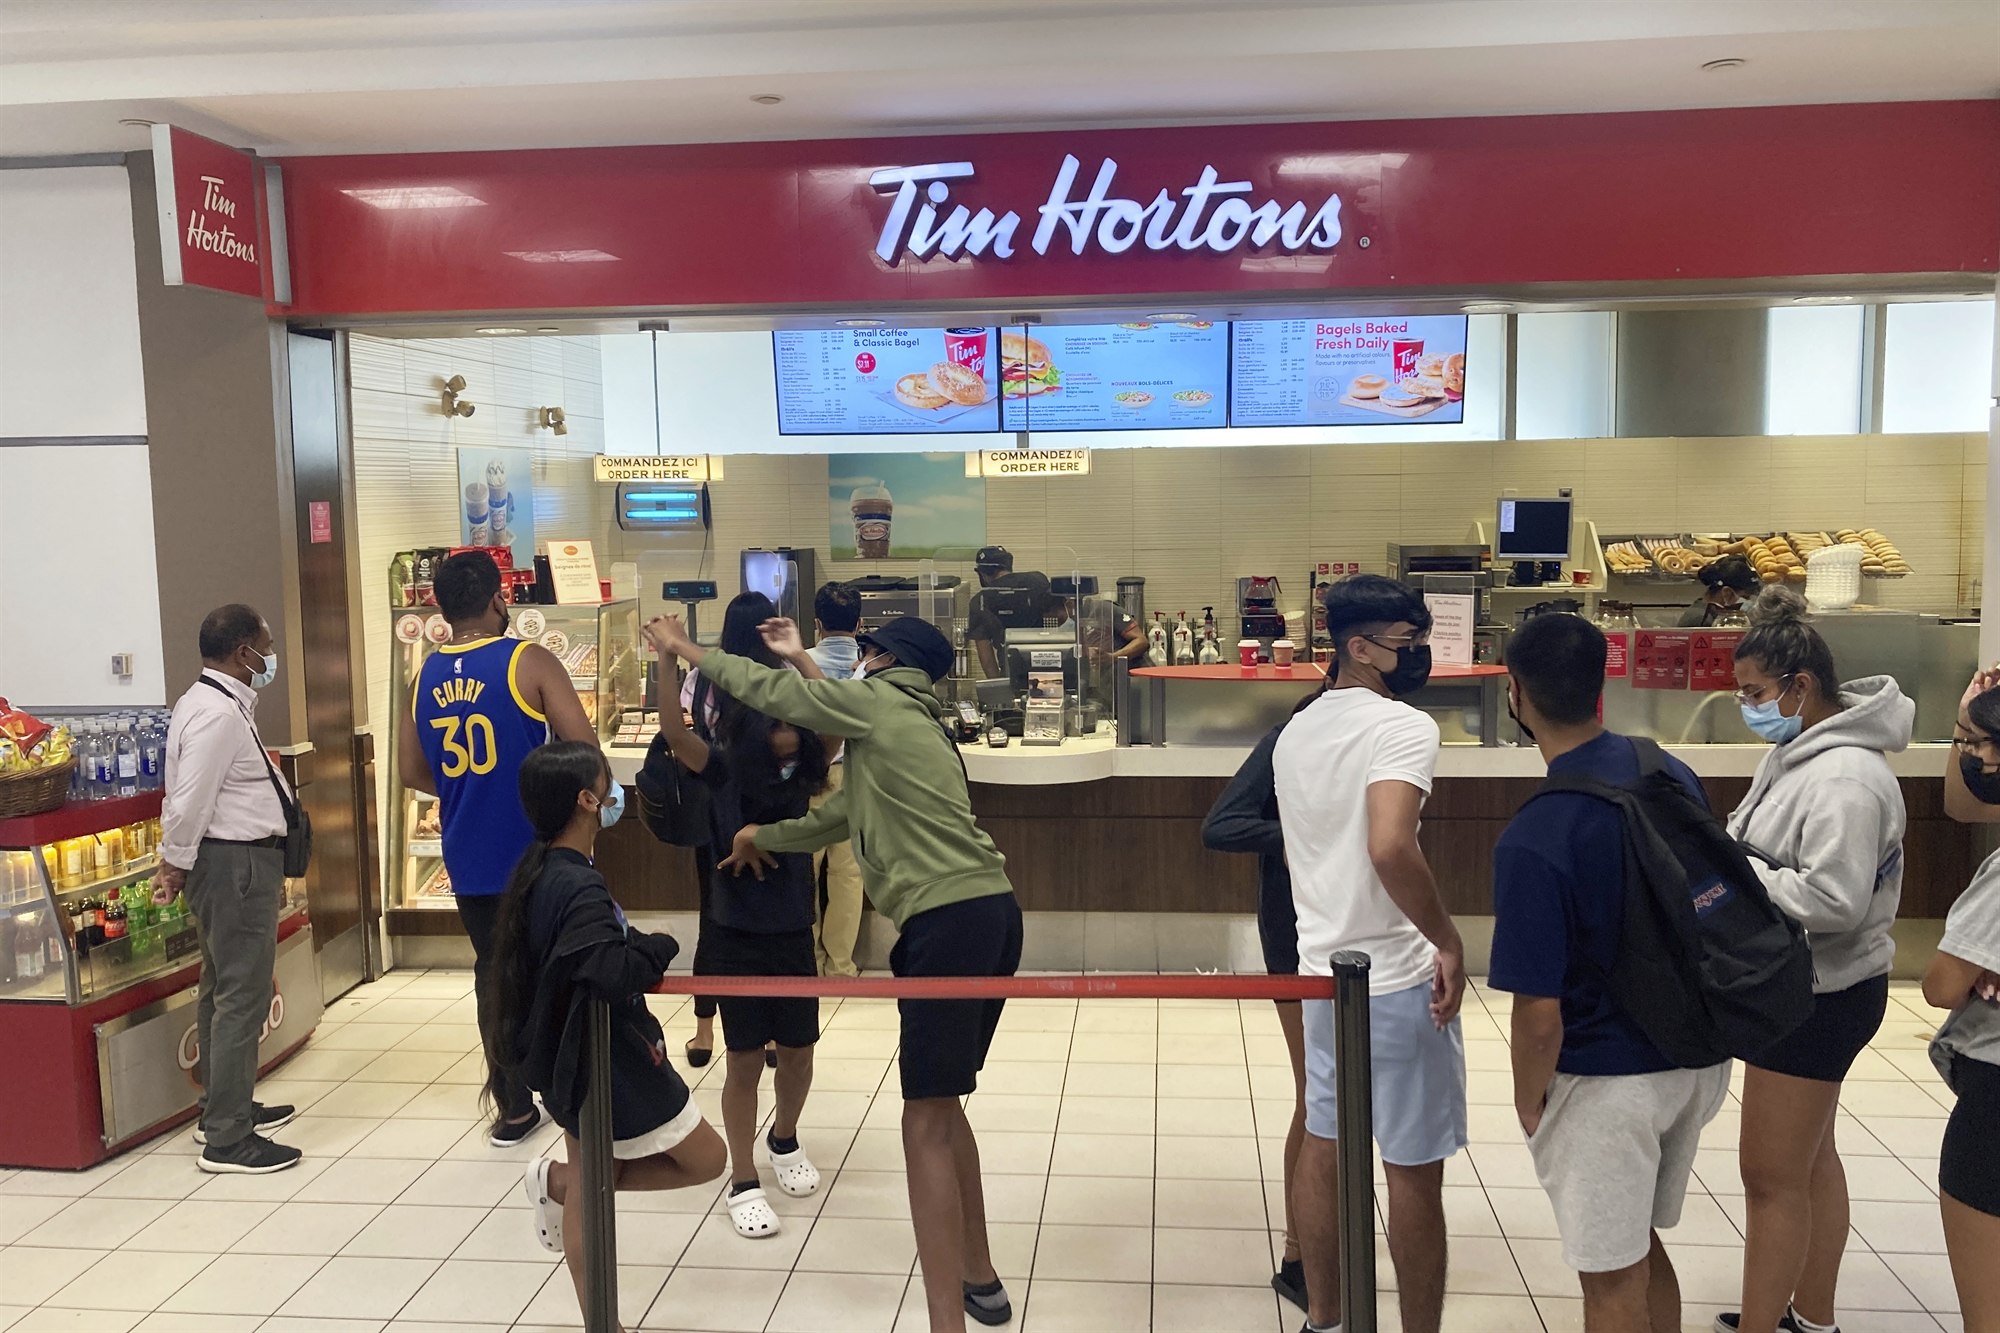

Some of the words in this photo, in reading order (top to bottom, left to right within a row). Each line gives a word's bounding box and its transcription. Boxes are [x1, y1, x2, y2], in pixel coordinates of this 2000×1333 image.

[200, 175, 236, 219] Tim
[868, 161, 1022, 263] Tim
[1031, 153, 1343, 256] Hortons
[187, 209, 255, 263] Hortons
[853, 328, 878, 338] Small
[879, 328, 909, 337] Coffee
[1316, 323, 1362, 338] Bagels
[1366, 321, 1408, 334] Baked
[853, 339, 861, 347] &
[862, 338, 893, 347] Classic
[894, 338, 920, 348] Bagel
[949, 340, 978, 362] Tim
[1315, 338, 1352, 350] Fresh
[1355, 337, 1390, 351] Daily
[601, 458, 679, 467] COMMANDEZ
[682, 458, 698, 467] ICI
[990, 450, 1072, 461] COMMANDEZ
[1074, 450, 1085, 459] ICI
[608, 470, 649, 479] ORDER
[653, 470, 689, 479] HERE
[1000, 463, 1046, 473] ORDER
[1050, 462, 1079, 472] HERE
[432, 678, 486, 708] CURRY
[429, 713, 498, 778] 30
[146, 747, 157, 774] smart
